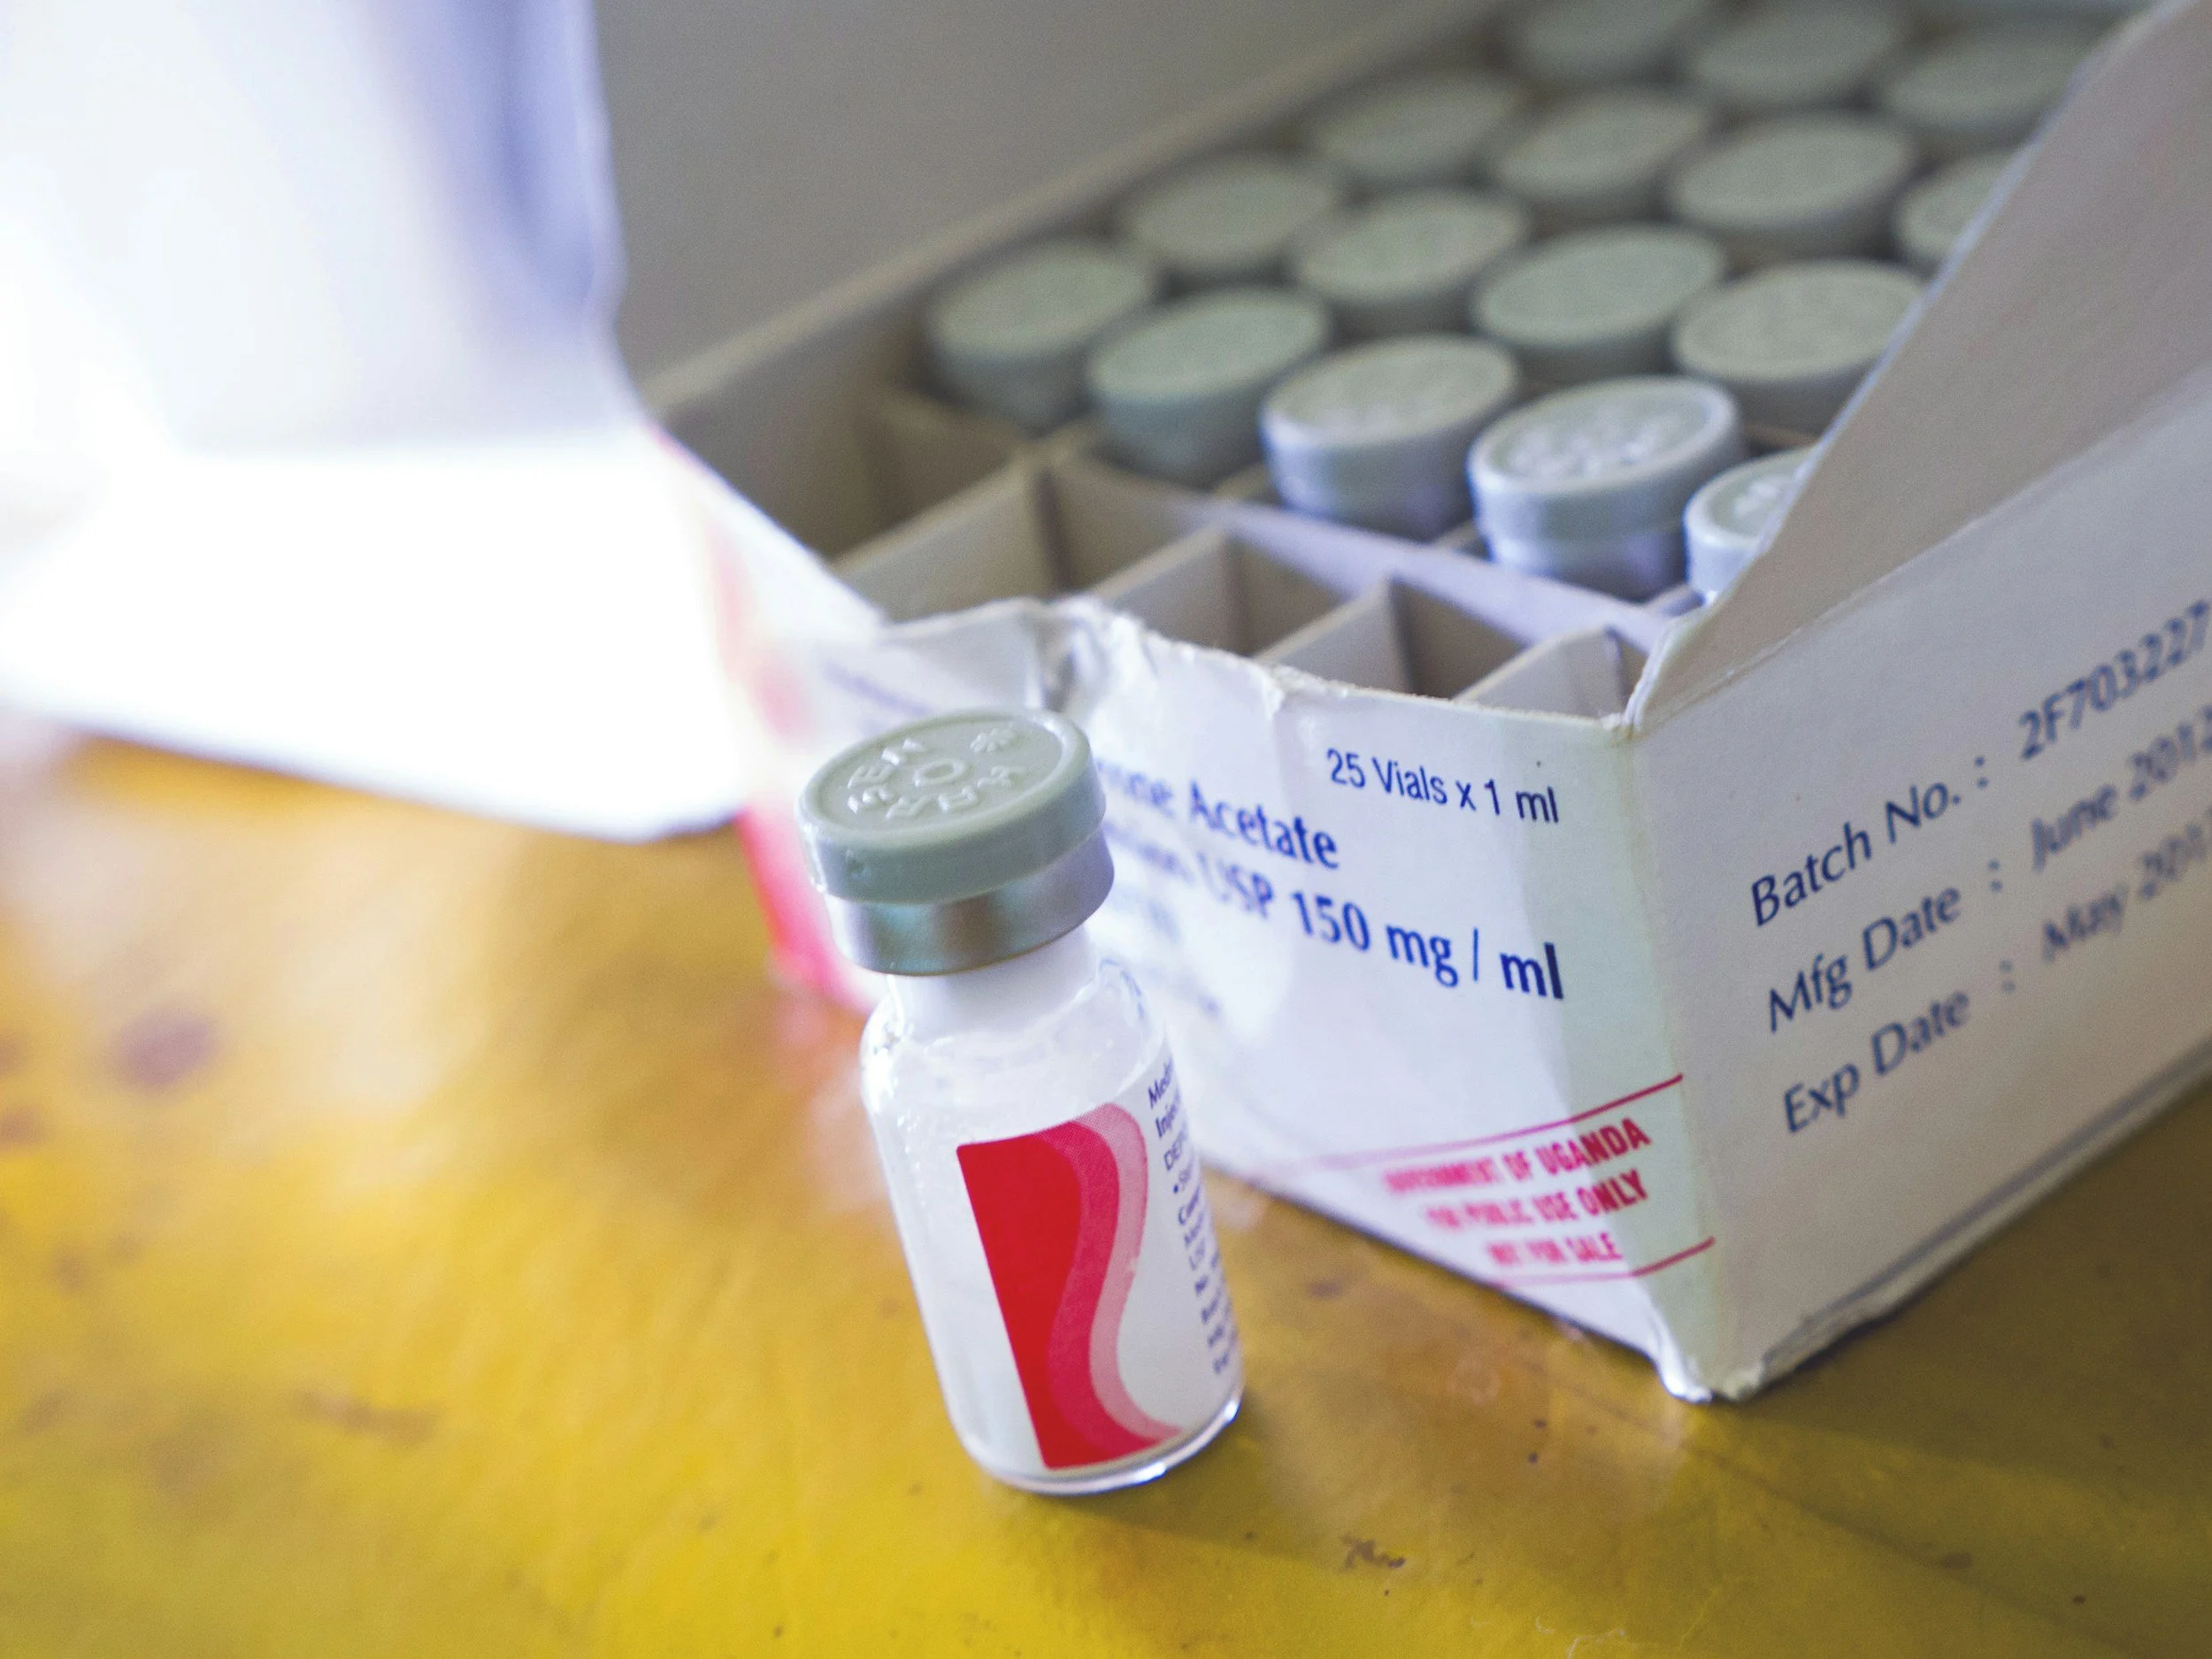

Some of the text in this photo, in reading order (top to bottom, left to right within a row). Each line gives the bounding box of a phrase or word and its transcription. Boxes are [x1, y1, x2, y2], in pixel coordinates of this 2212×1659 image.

[1327, 749, 1560, 824] 25 Vials x 1 ml
[1750, 821, 1872, 927] Batch
[1885, 782, 1962, 845] No.
[2018, 598, 2211, 761] 2F703227
[1189, 778, 1339, 870] Acetate
[1195, 851, 1274, 919] USP
[1291, 889, 1371, 953] 150
[1386, 924, 1459, 987] mg
[1500, 942, 1564, 1000] ml
[1768, 953, 1854, 1033] Mfg
[1861, 887, 1962, 972] Date
[2032, 783, 2118, 873] June
[1782, 1063, 1861, 1134] Exp
[1869, 992, 1971, 1076] Date
[2041, 883, 2127, 964] May
[1534, 1118, 1652, 1175] UGANDA
[1576, 1168, 1647, 1216] ONLY
